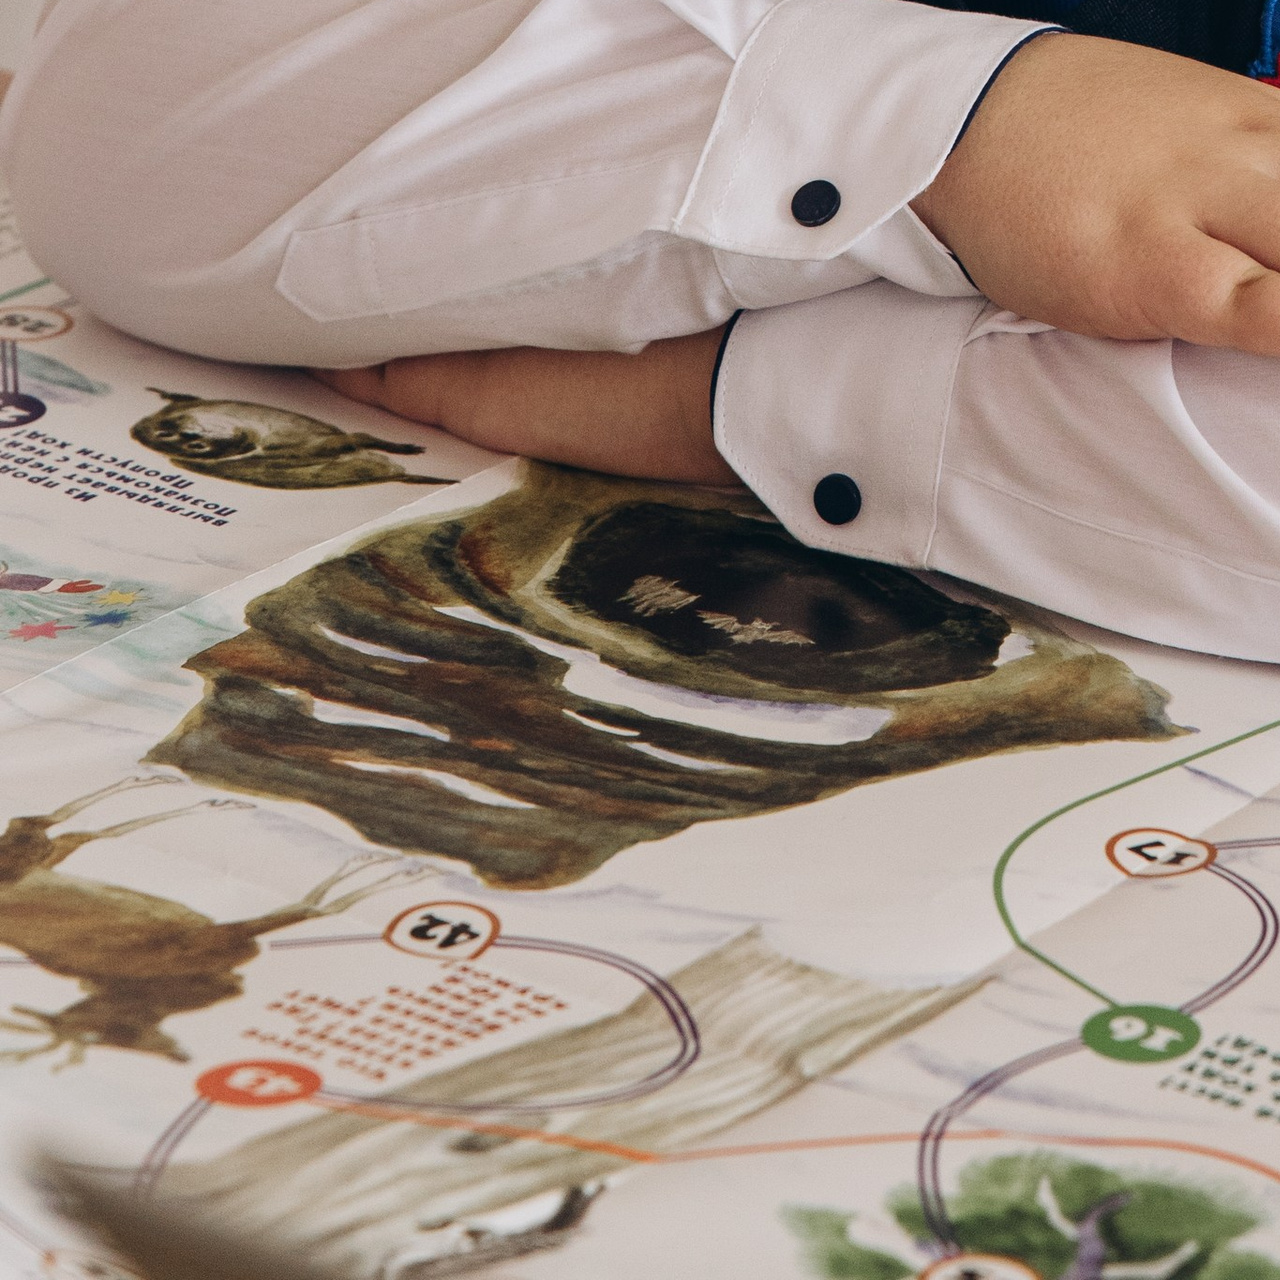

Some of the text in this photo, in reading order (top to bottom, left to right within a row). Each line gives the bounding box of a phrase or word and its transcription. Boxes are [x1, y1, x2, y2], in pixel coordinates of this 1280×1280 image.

[11, 428, 195, 491] Пропусти ход!
[54, 454, 71, 464] с
[62, 472, 230, 528] выглядывает
[63, 487, 98, 503] Из
[75, 461, 238, 518] Познакомься
[1126, 839, 1200, 867] 17
[409, 913, 481, 950] 42
[1107, 1014, 1185, 1053] 16
